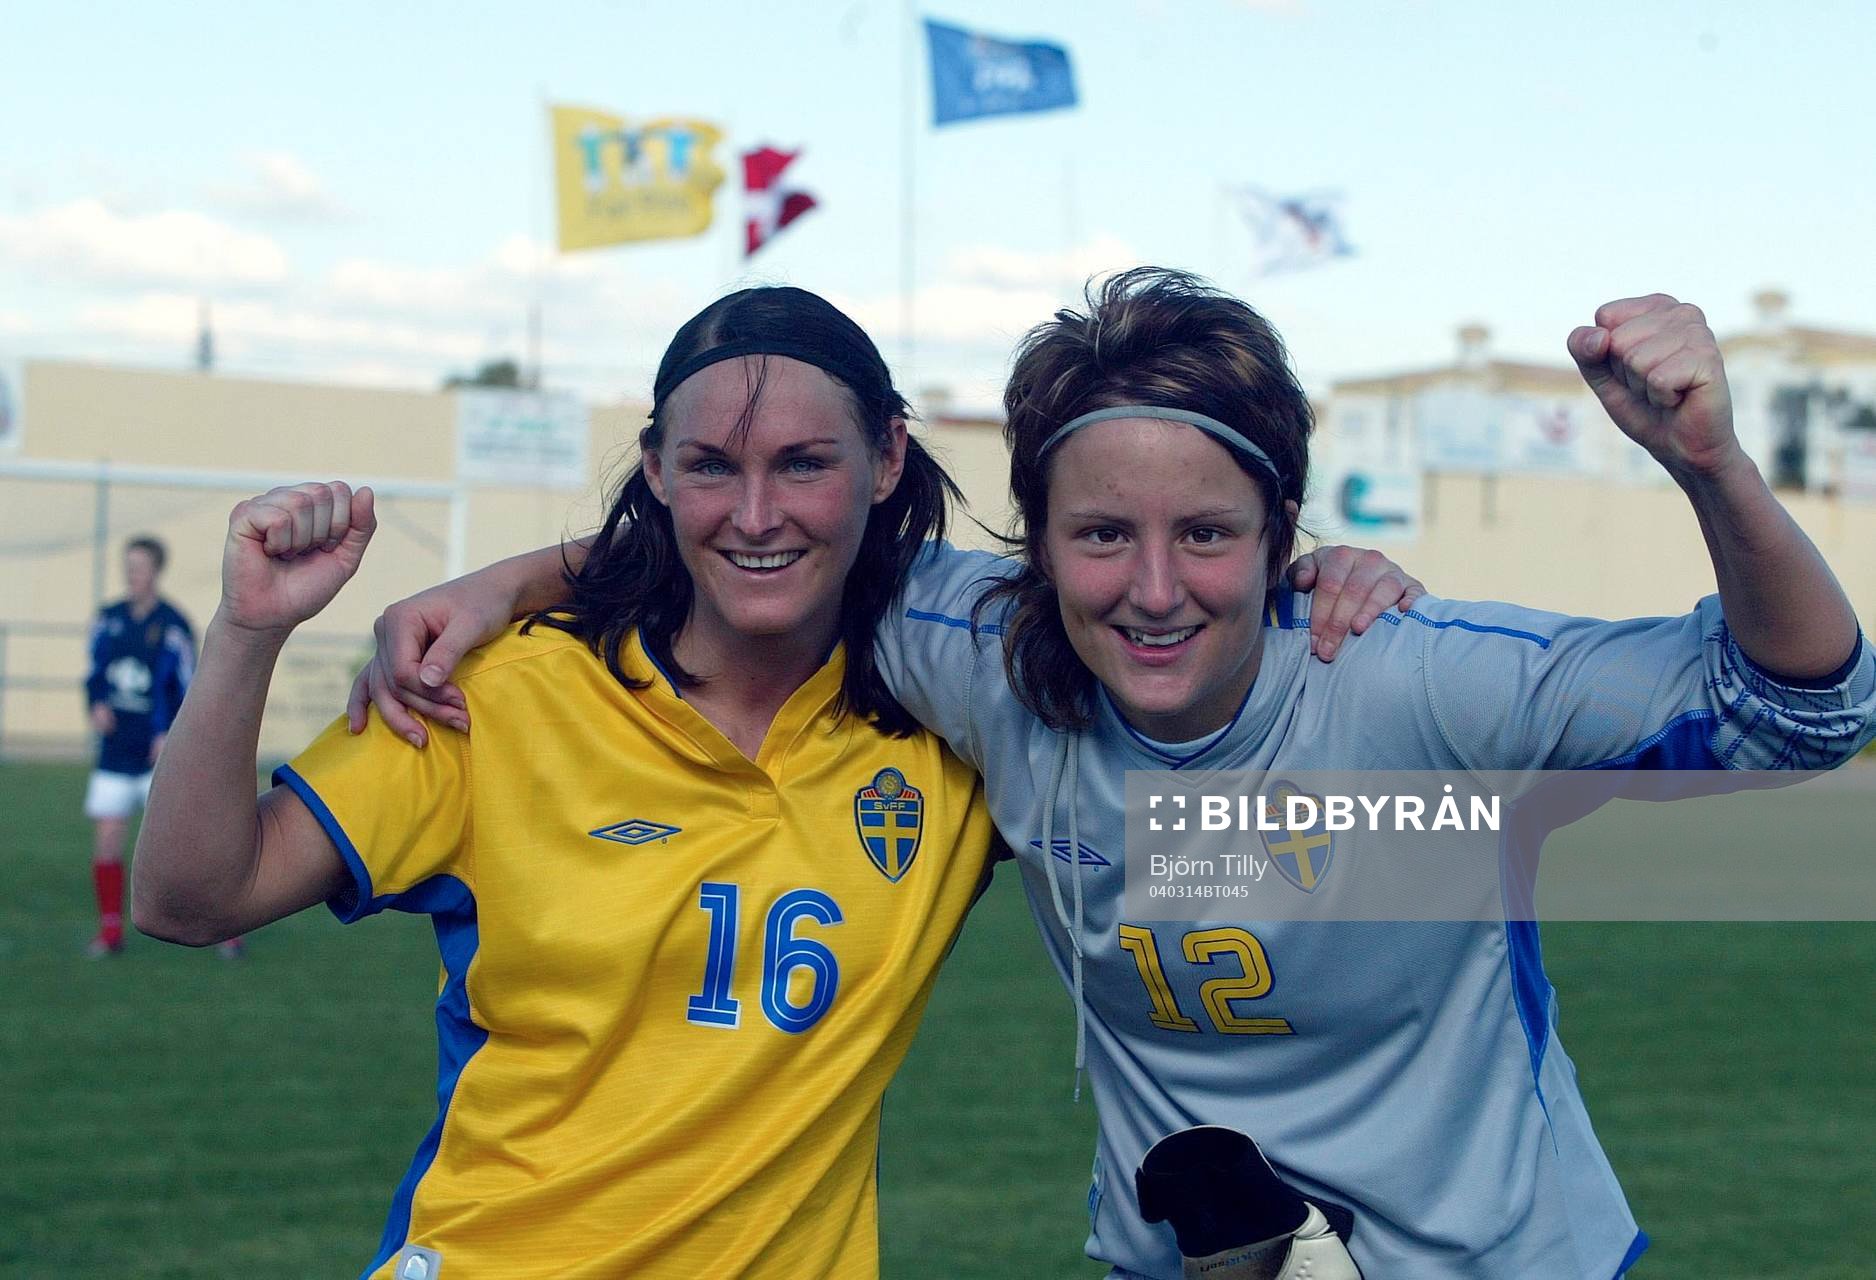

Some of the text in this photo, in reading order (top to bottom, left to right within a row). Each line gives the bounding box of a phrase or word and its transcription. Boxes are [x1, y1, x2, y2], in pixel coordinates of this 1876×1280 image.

[873, 801, 906, 810] SvFF
[687, 882, 845, 1035] 16
[1118, 922, 1298, 1036] 12
